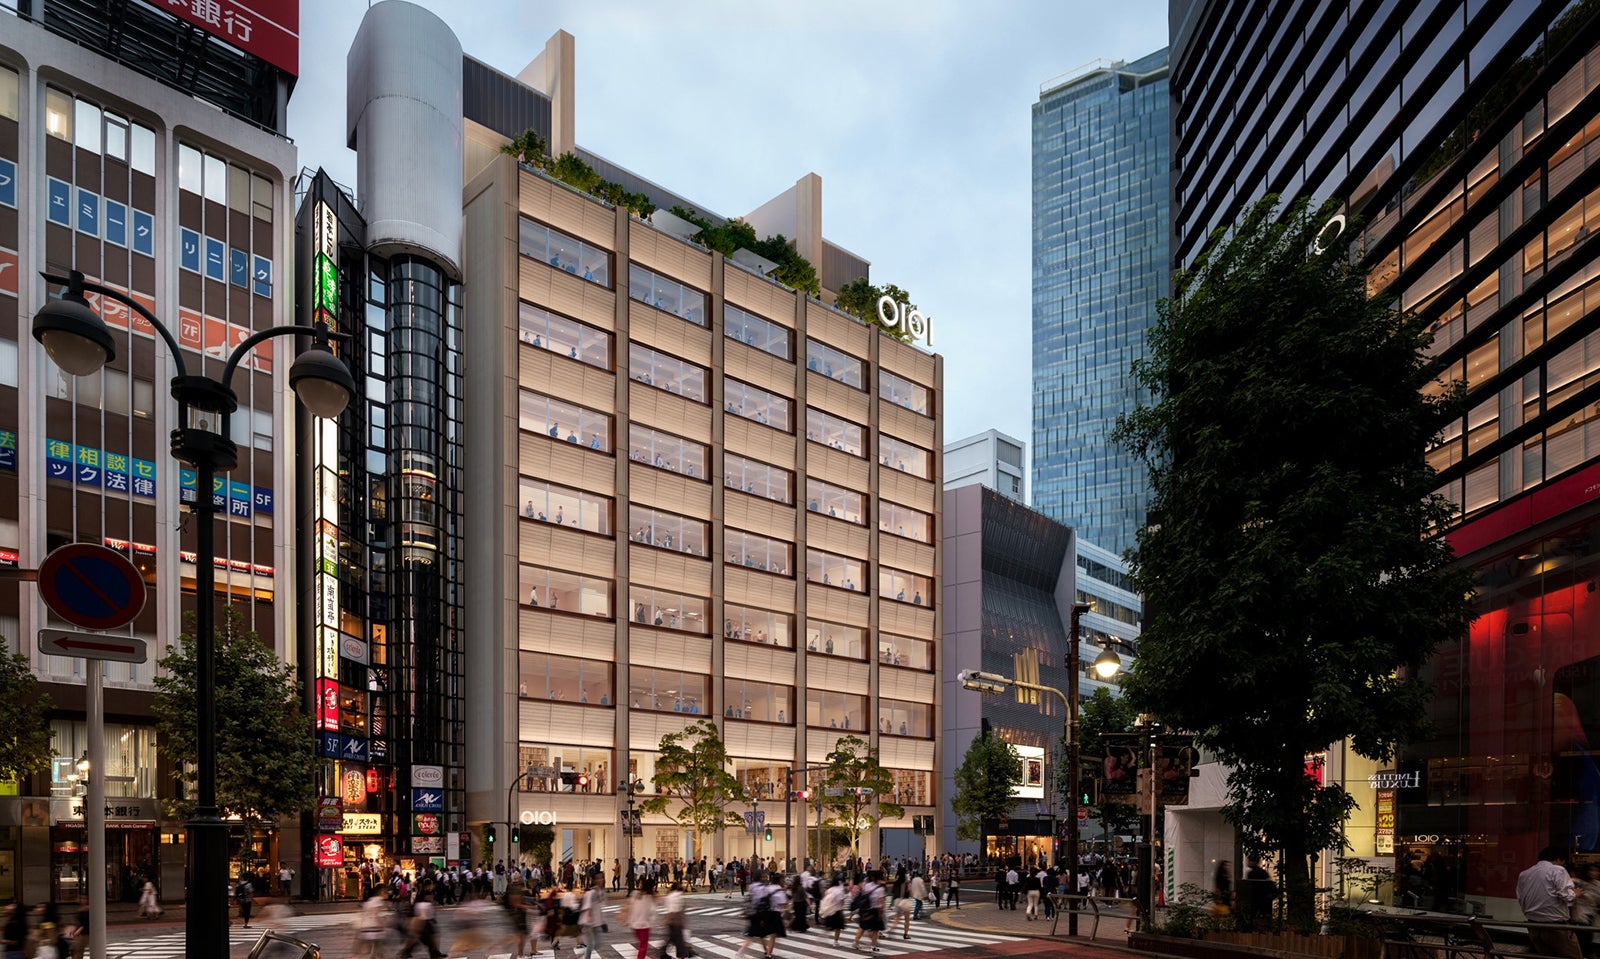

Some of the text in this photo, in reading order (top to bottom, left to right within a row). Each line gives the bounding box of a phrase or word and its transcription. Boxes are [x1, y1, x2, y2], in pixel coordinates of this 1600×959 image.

[182, 323, 199, 337] 7F
[255, 493, 271, 506] 5F
[326, 737, 339, 752] 5F
